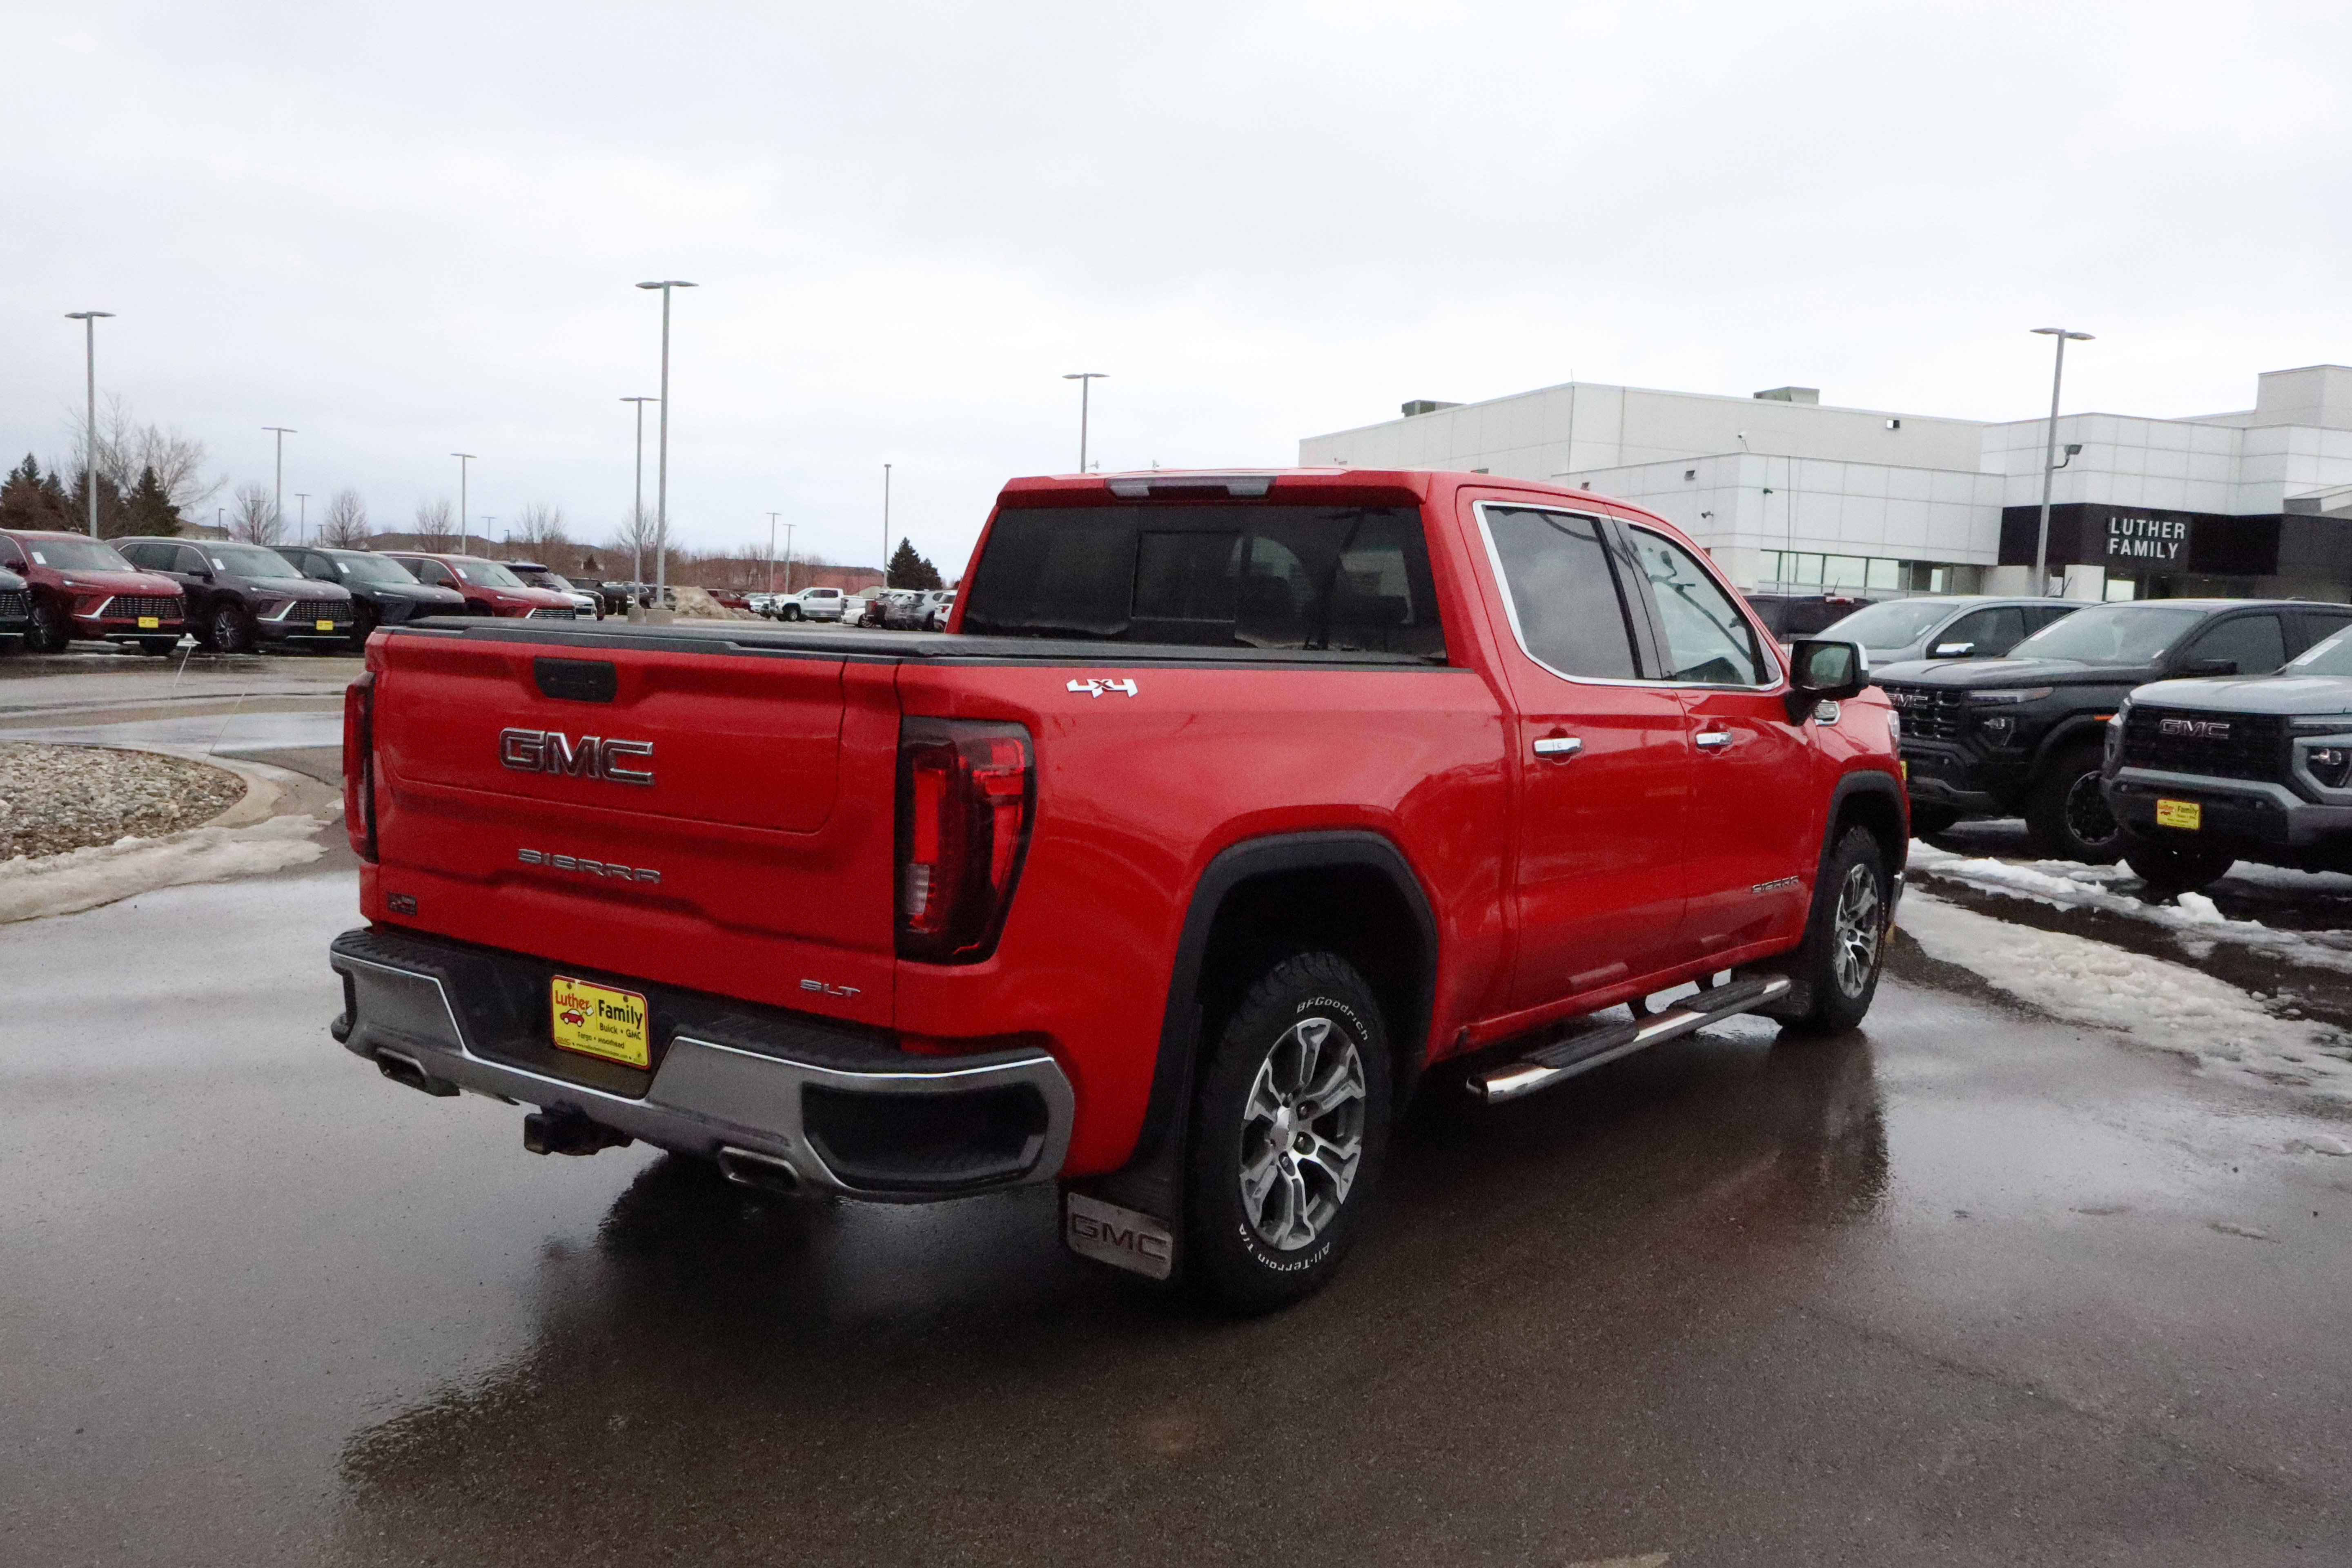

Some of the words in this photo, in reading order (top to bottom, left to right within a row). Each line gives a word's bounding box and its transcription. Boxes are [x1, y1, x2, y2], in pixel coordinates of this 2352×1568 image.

[2111, 517, 2185, 539] LUTHER
[2109, 538, 2178, 559] FAMILY
[2159, 719, 2230, 739] GMC
[499, 727, 655, 785] GMC
[2178, 804, 2198, 816] Family
[518, 848, 661, 884] SIERRA
[1752, 875, 1799, 893] SIERRA
[800, 979, 861, 997] SLT
[555, 990, 590, 1010] Luther
[598, 999, 643, 1030] Family
[1296, 996, 1368, 1041] BFGoodrich
[599, 1022, 618, 1035] Buick
[626, 1029, 641, 1040] GMC
[597, 1037, 624, 1049] Moorhead
[1072, 1212, 1167, 1261] GMC
